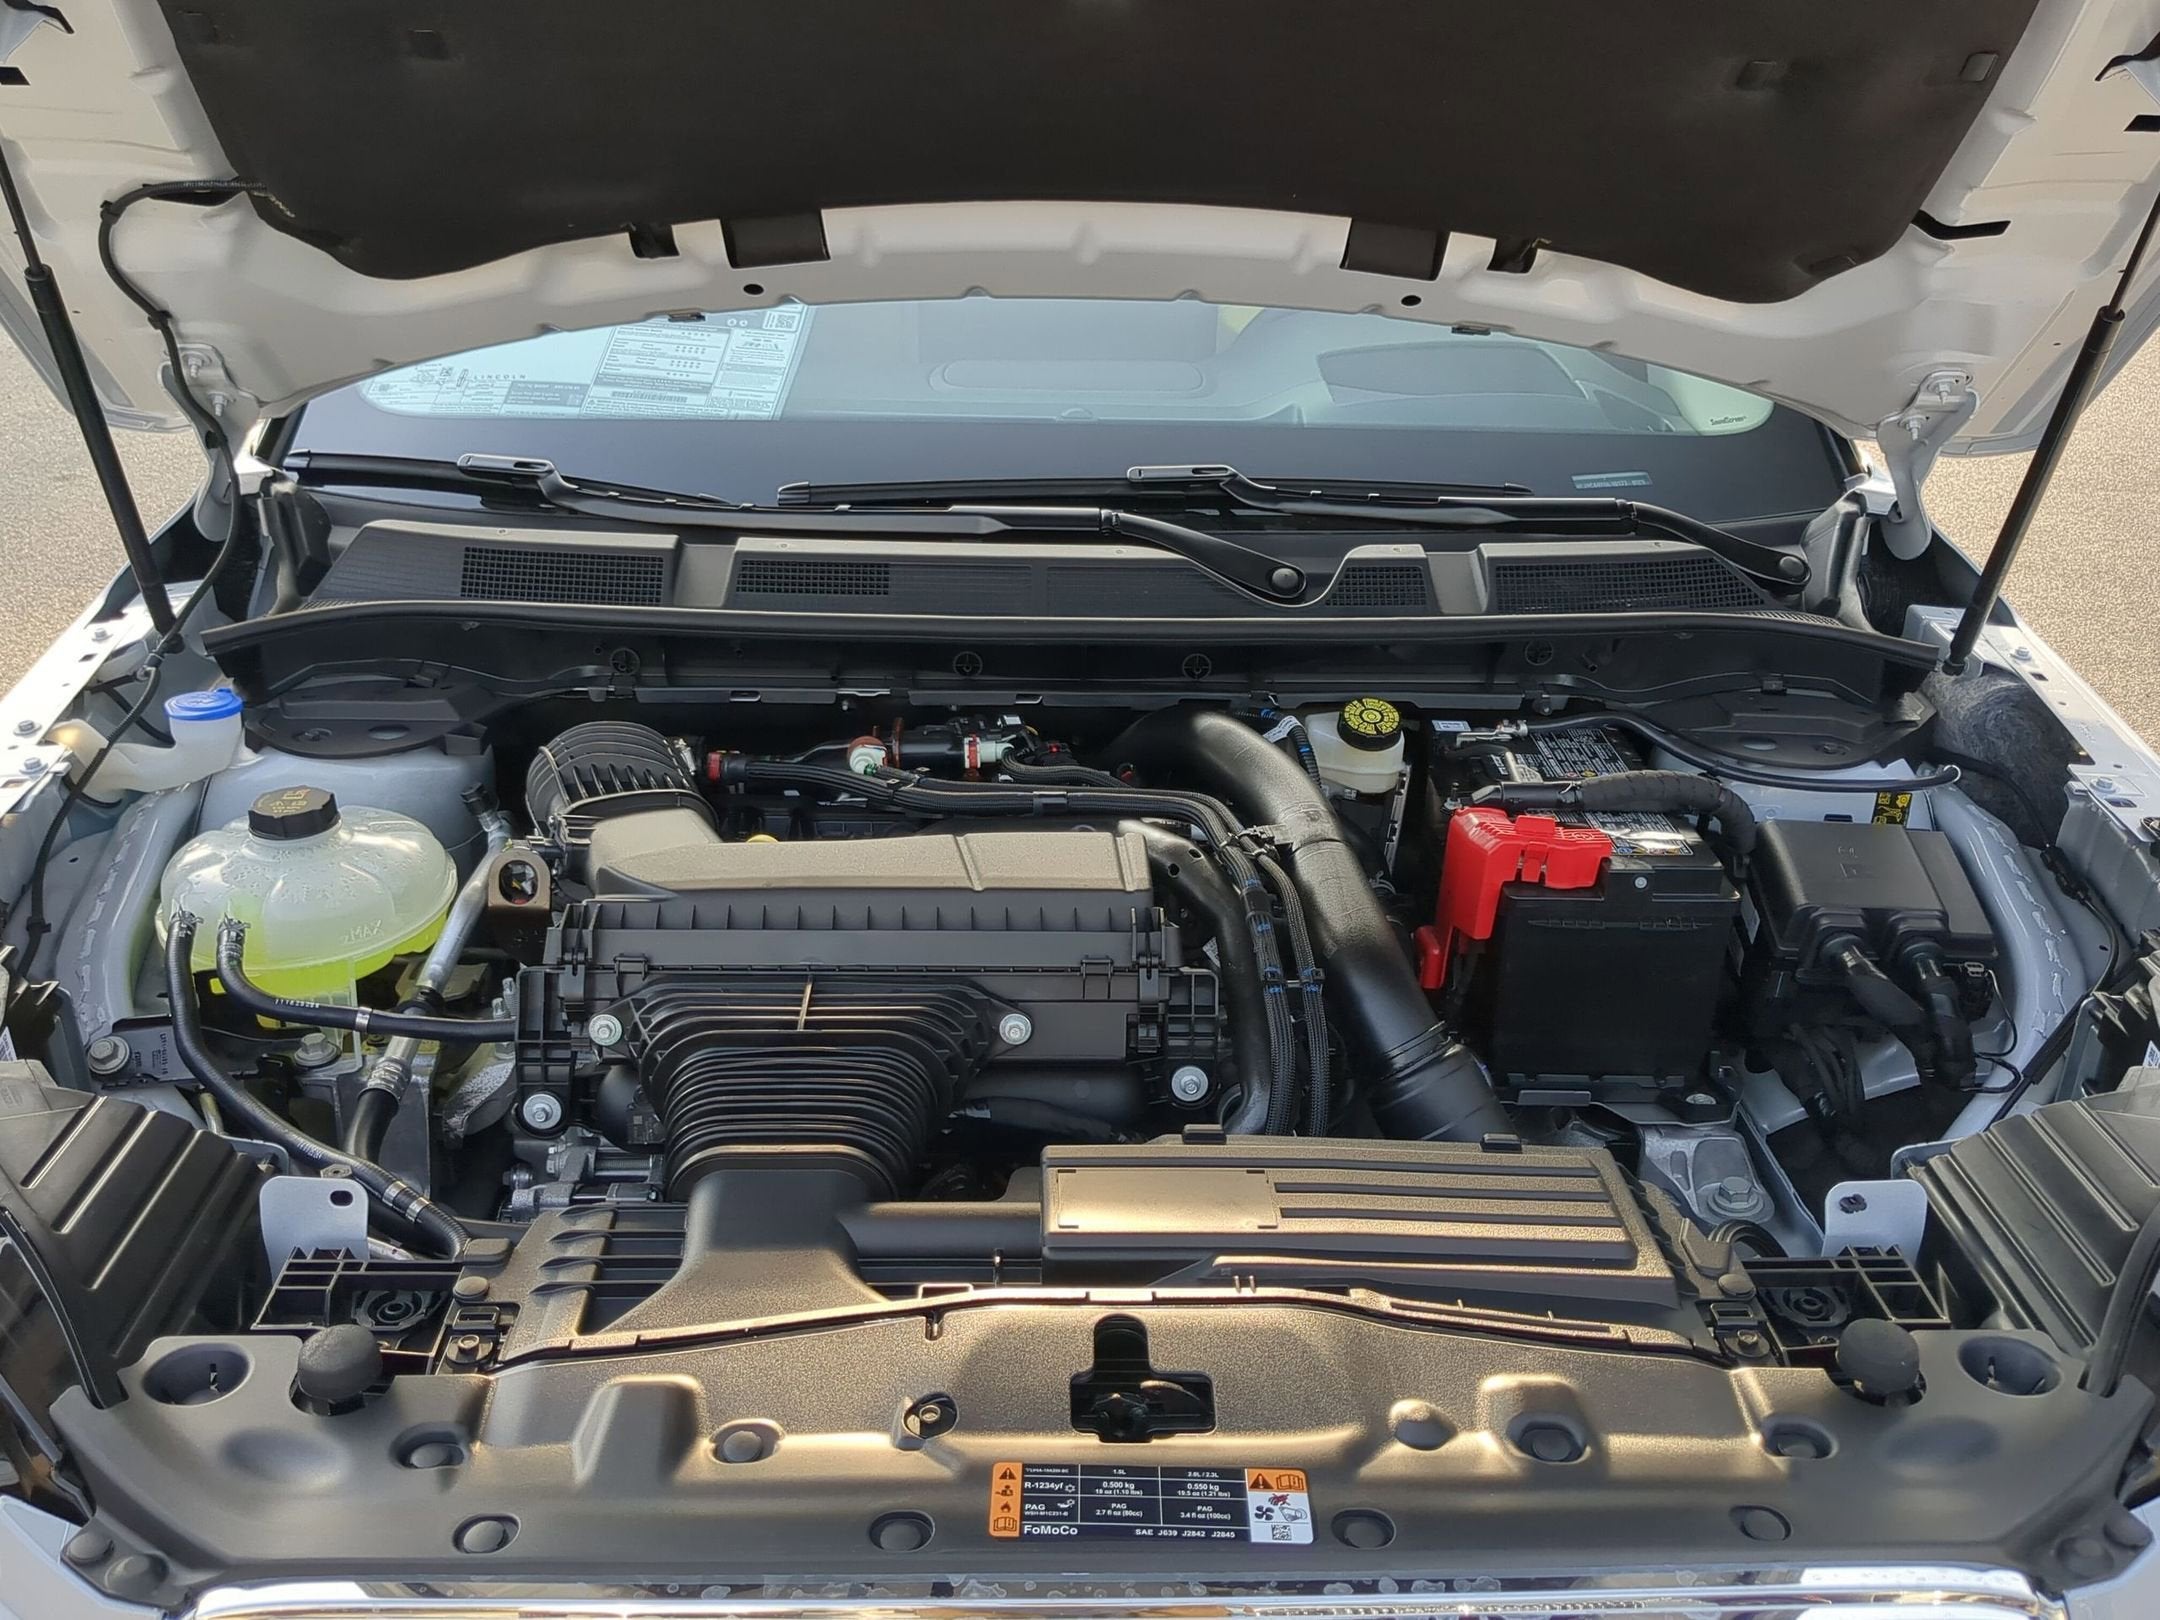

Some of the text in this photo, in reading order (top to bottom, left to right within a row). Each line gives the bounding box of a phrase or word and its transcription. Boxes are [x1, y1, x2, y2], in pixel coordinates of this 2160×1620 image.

[350, 919, 385, 941] MAX
[1024, 1481, 1064, 1490] R-1234yf
[1124, 1481, 1135, 1490] kg
[1209, 1483, 1220, 1491] kg
[1024, 1503, 1046, 1511] PAG
[1023, 1524, 1078, 1535] FoMoCo
[1135, 1528, 1154, 1536] SAE
[1157, 1529, 1178, 1537] J639
[1182, 1530, 1206, 1538] J2842
